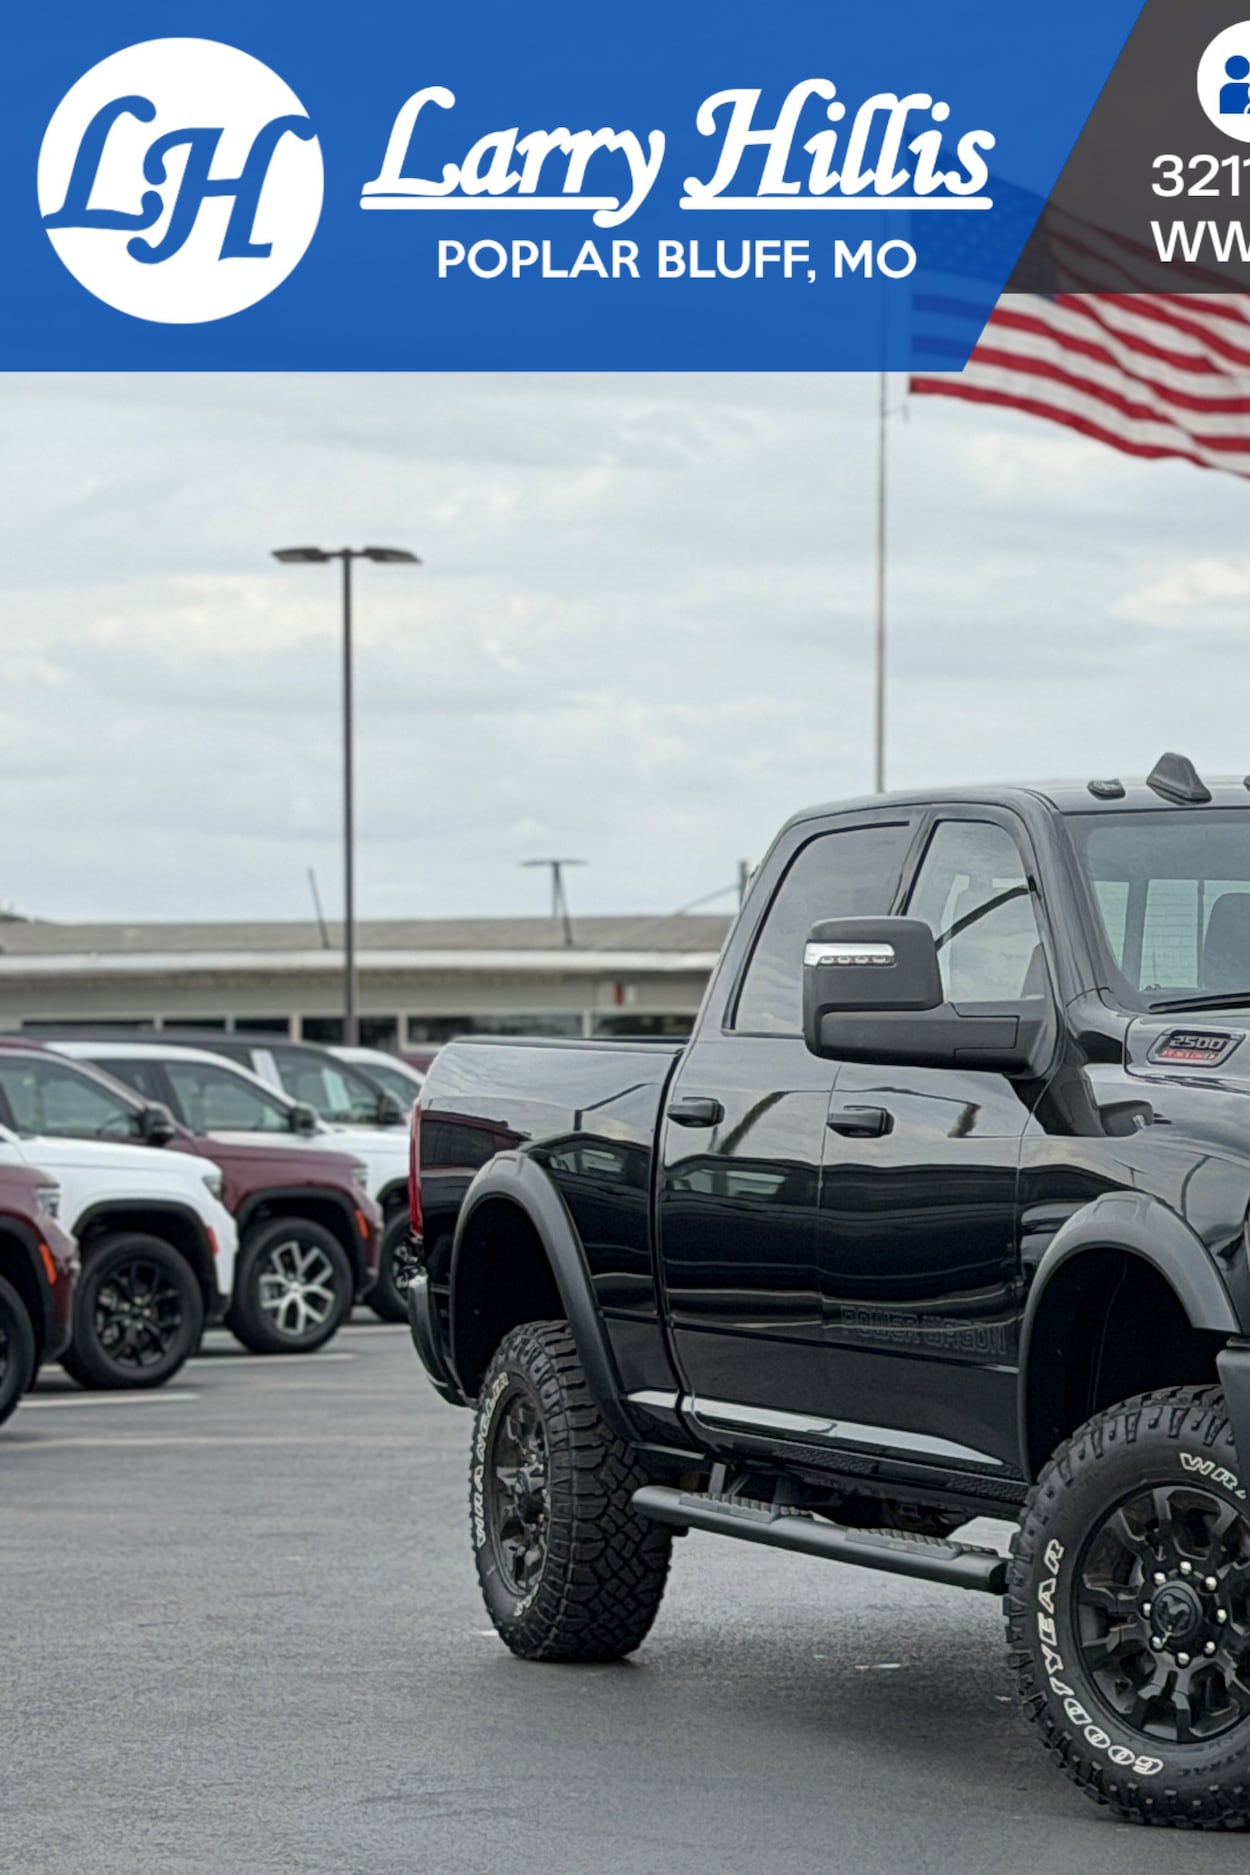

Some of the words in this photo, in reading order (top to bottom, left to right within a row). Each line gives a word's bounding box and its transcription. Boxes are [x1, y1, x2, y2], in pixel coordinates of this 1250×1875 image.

[1170, 1035, 1223, 1051] 2500
[840, 1304, 920, 1344] POWER
[922, 1315, 1007, 1355] WAGON
[1037, 1539, 1164, 1775] GOODYEAR
